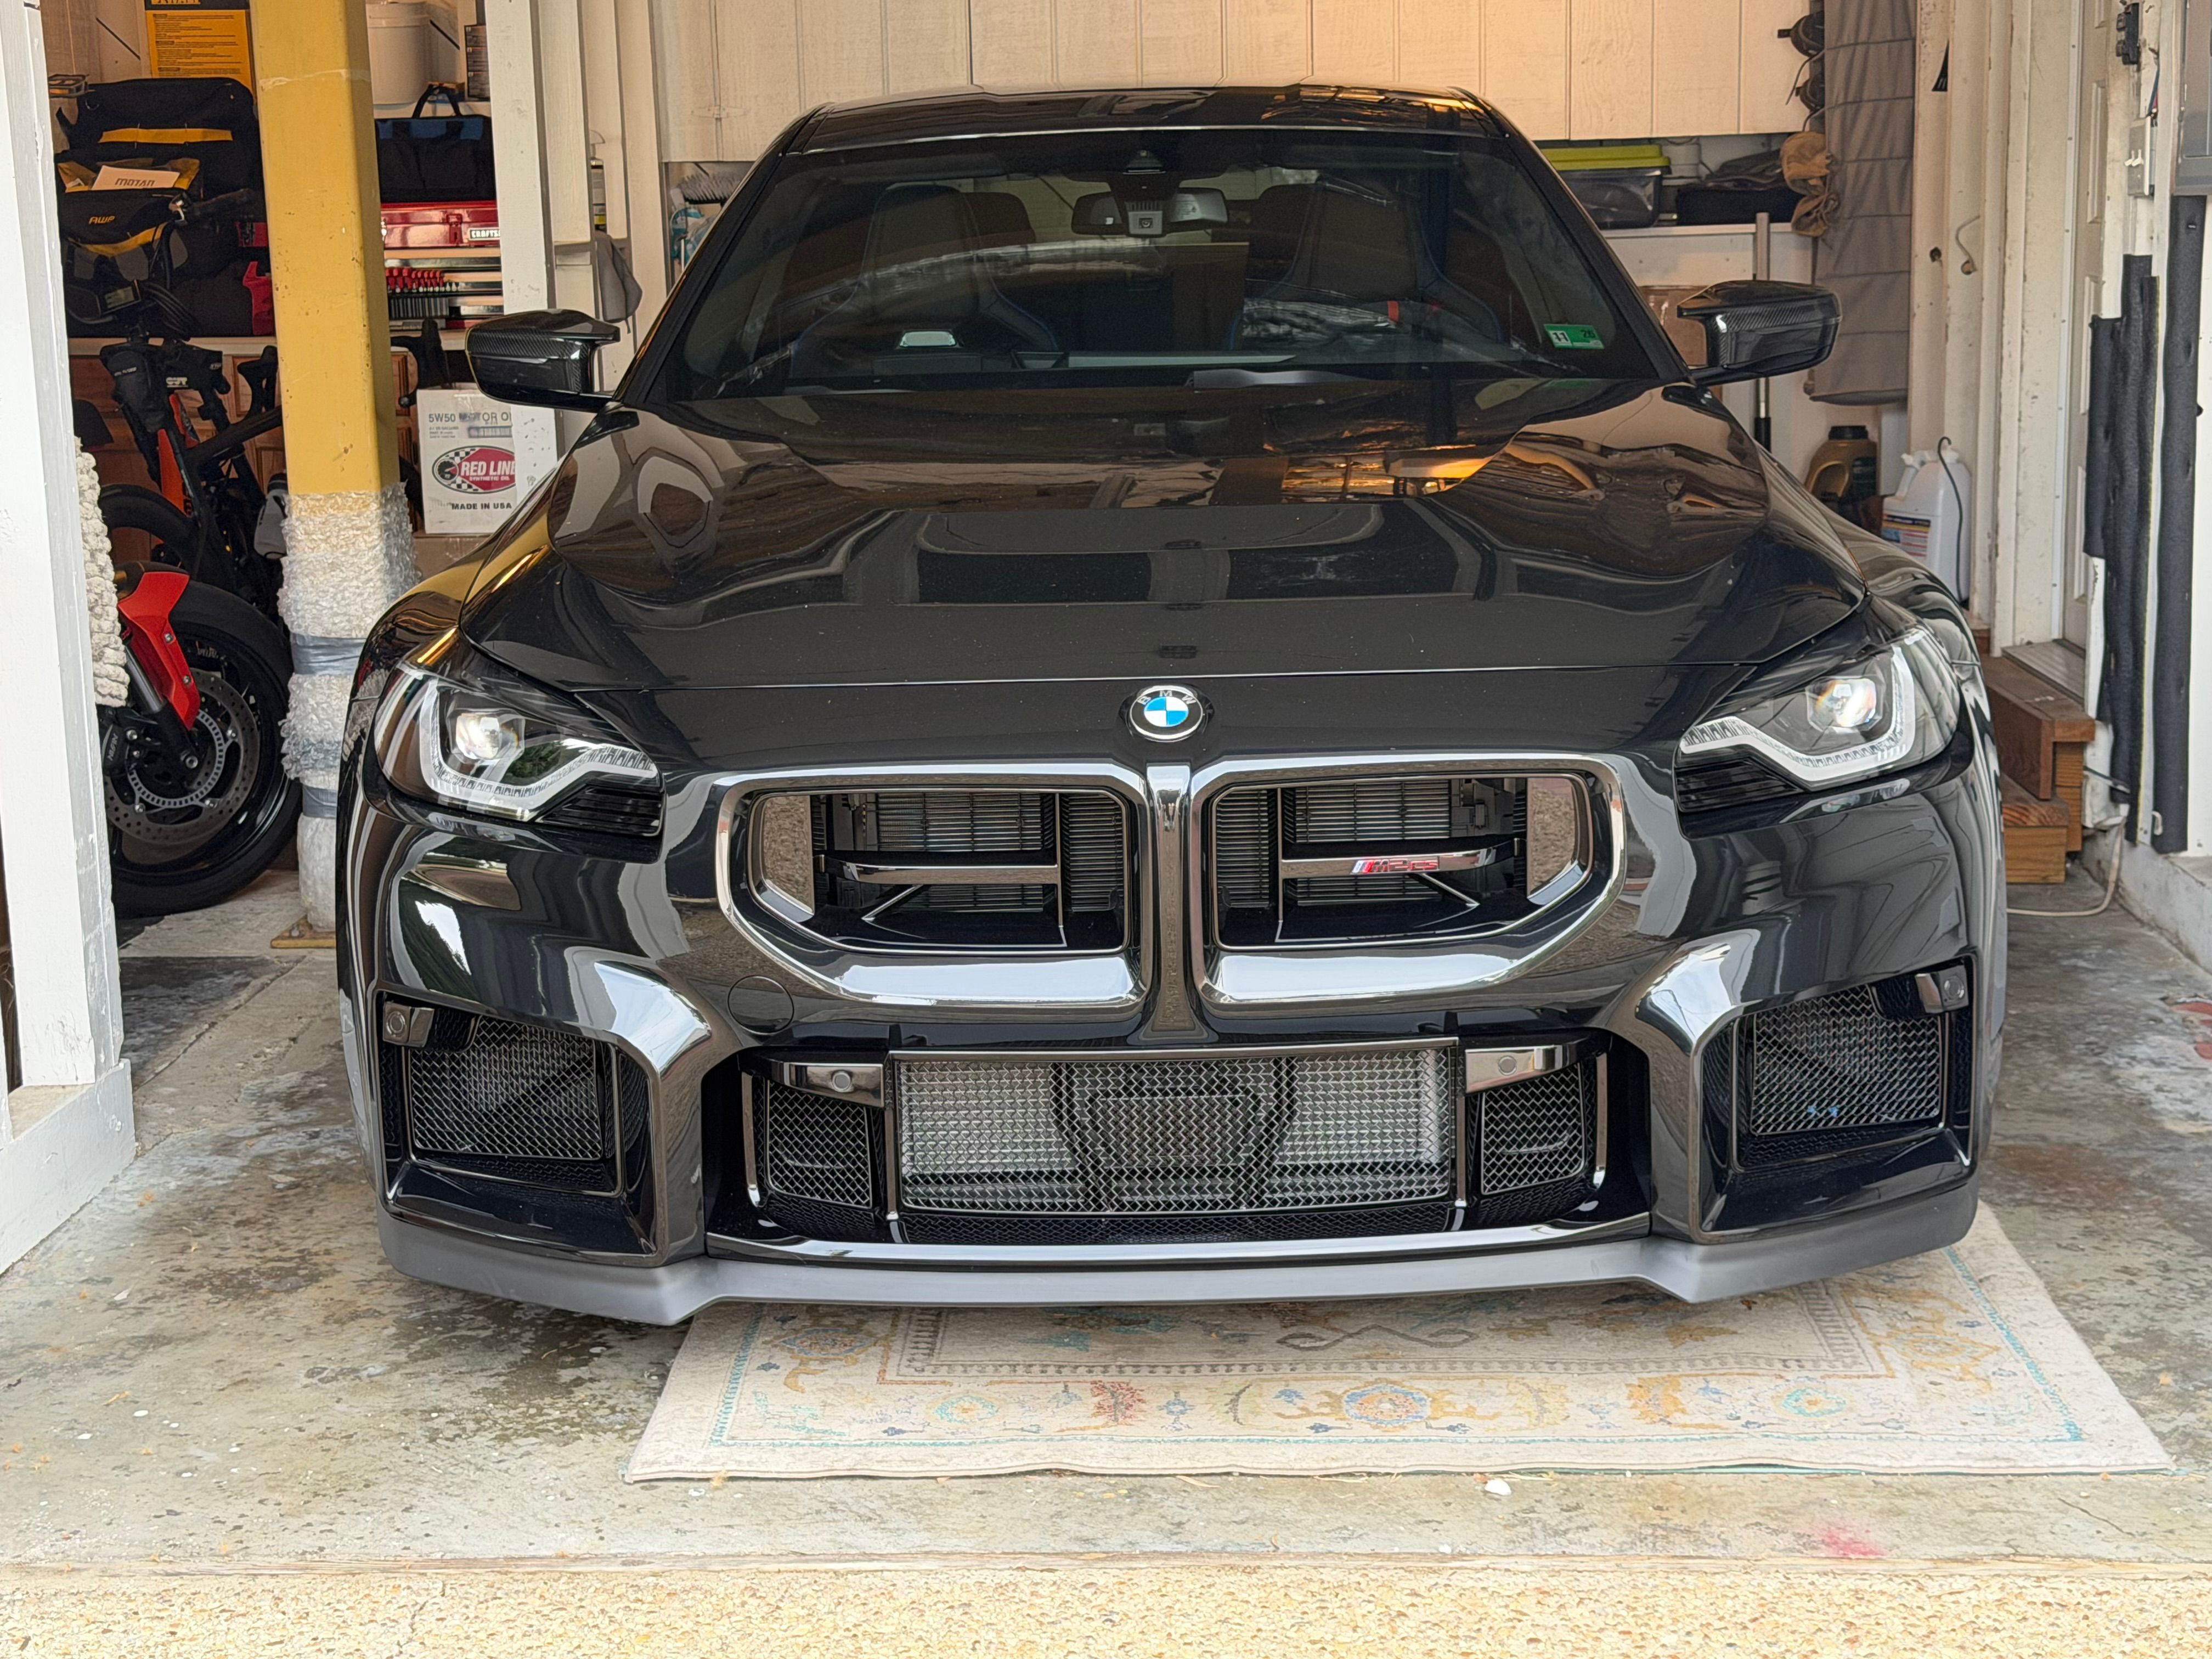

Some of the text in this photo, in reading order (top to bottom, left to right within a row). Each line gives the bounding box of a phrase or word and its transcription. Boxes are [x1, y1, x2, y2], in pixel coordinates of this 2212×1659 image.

[88, 216, 115, 224] AWP
[1552, 332, 1568, 342] 11
[428, 413, 456, 422] 5W50
[461, 461, 487, 476] RED
[1137, 690, 1197, 705] BMW
